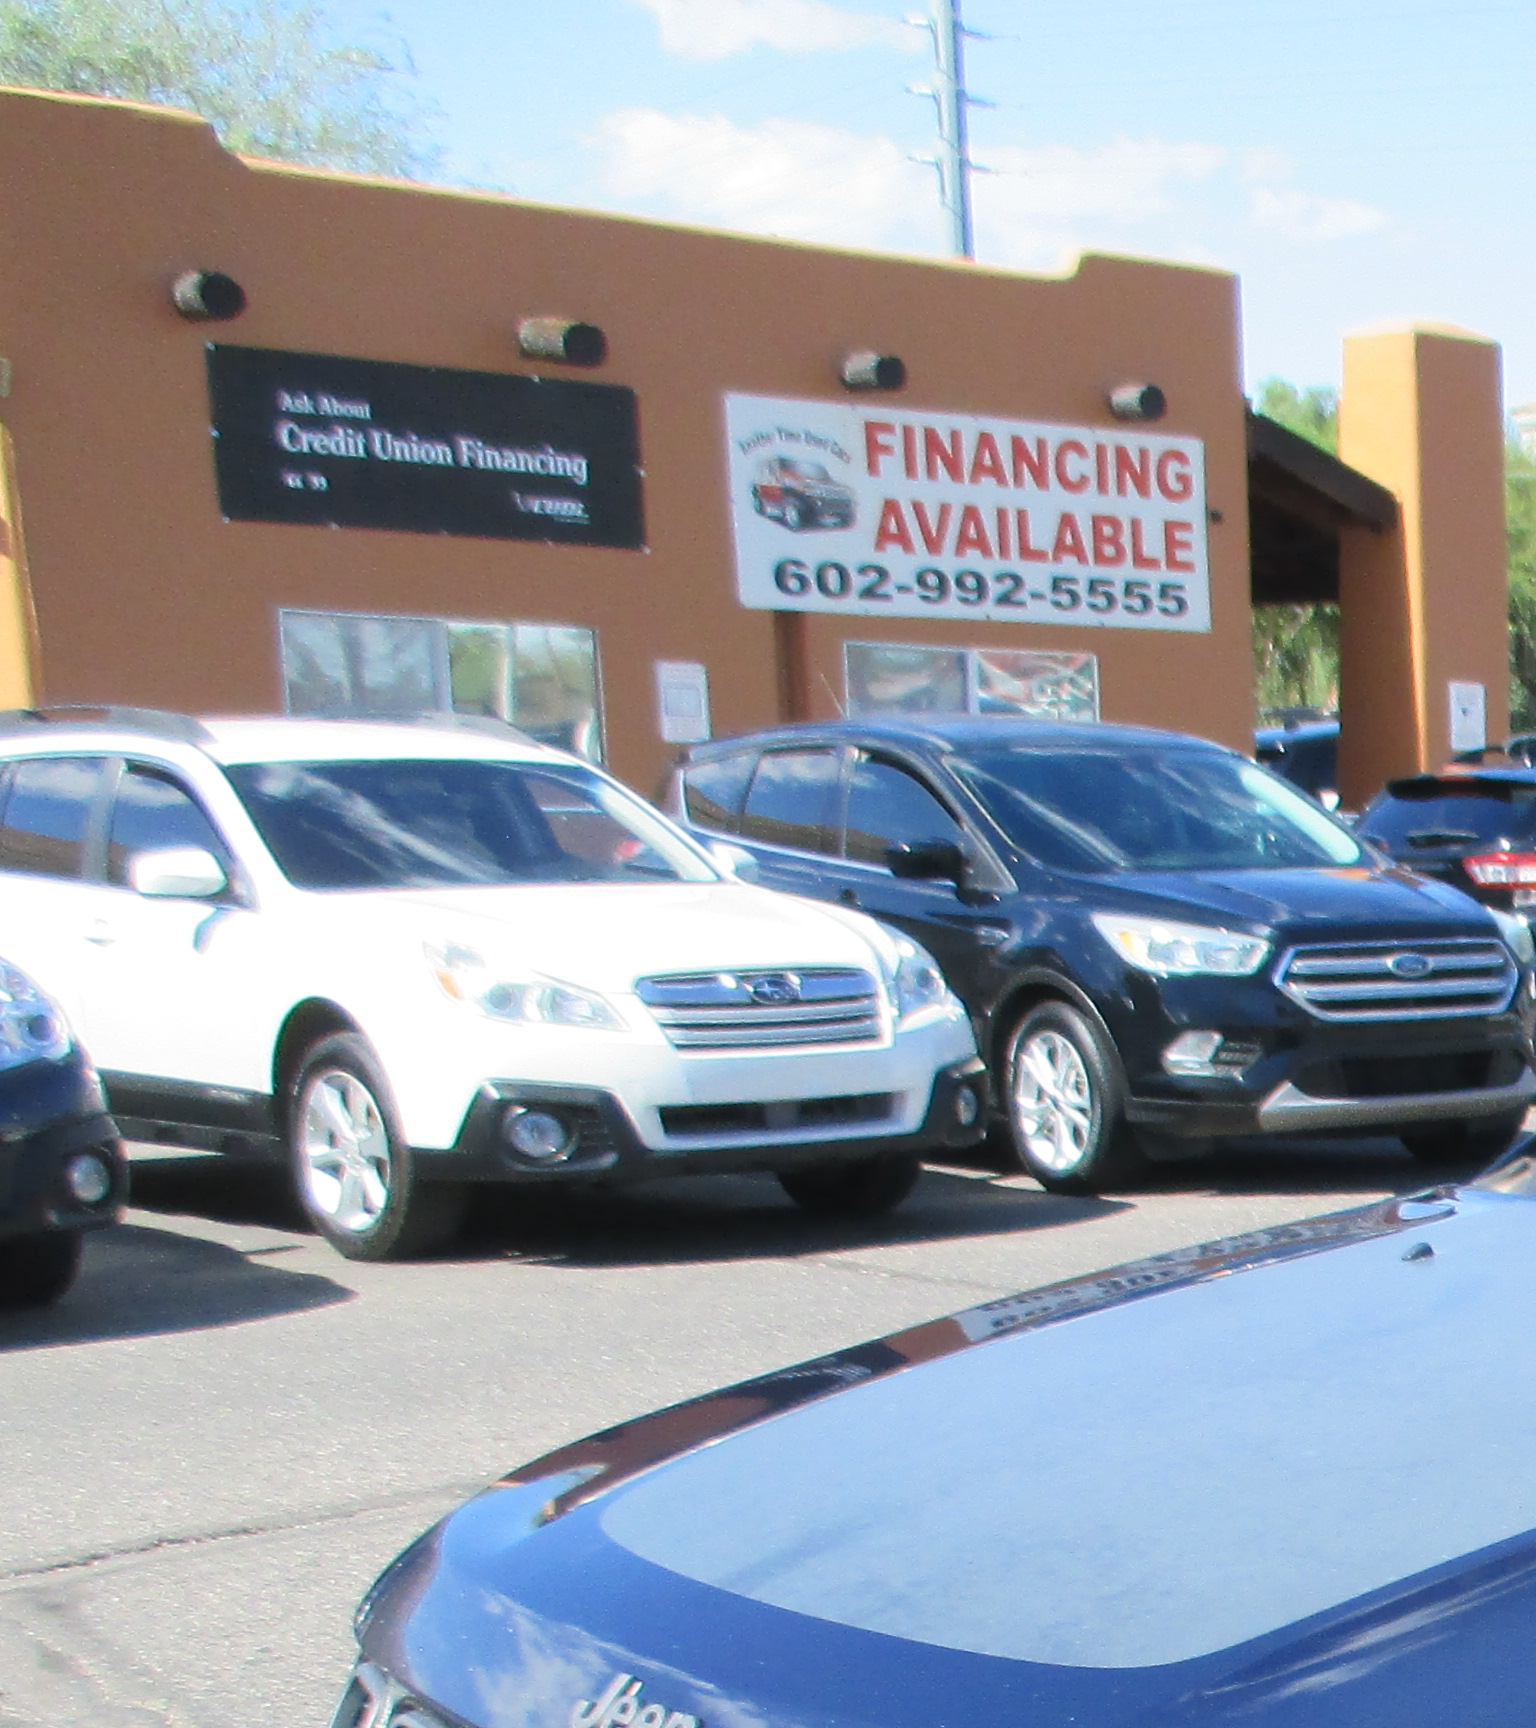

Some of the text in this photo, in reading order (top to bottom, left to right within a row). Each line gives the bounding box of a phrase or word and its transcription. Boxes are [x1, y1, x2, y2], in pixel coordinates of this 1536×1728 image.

[278, 390, 372, 420] Ask About
[275, 420, 589, 486] Credit Union Financing
[862, 420, 1195, 503] FINANCING
[874, 498, 1196, 573] AVAILABLE
[774, 558, 1190, 617] 602-992-5555
